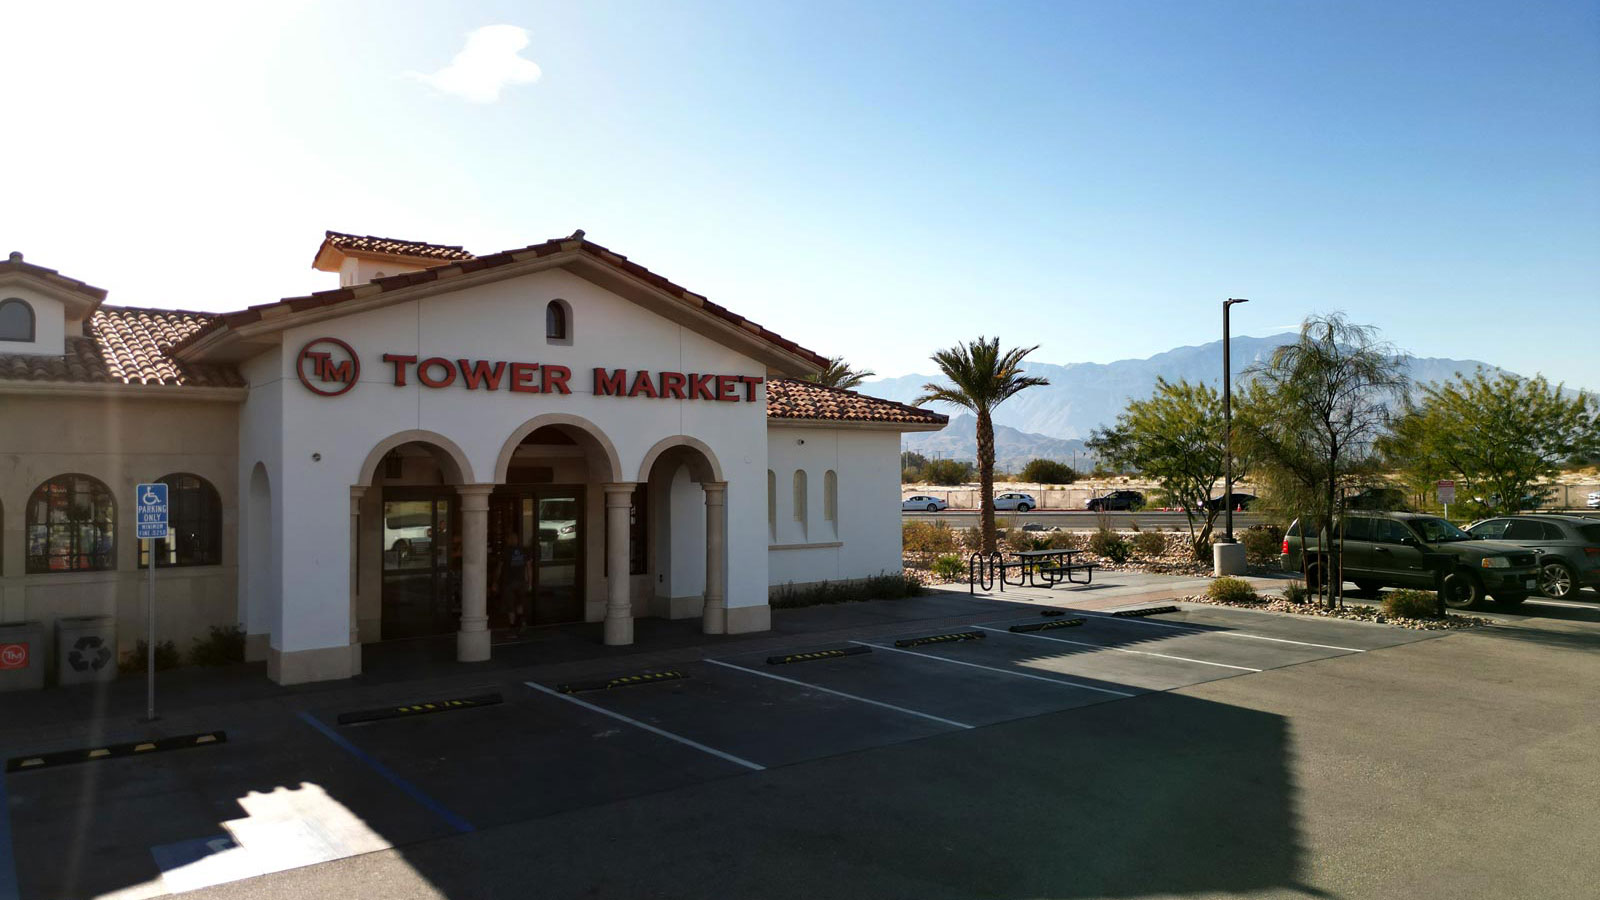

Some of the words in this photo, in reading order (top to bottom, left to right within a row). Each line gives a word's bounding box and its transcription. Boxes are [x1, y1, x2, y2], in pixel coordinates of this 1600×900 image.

[304, 351, 352, 384] TM
[382, 353, 573, 395] TOWER
[592, 367, 764, 402] MARKET
[138, 504, 167, 513] PARKING
[144, 513, 161, 522] ONLY
